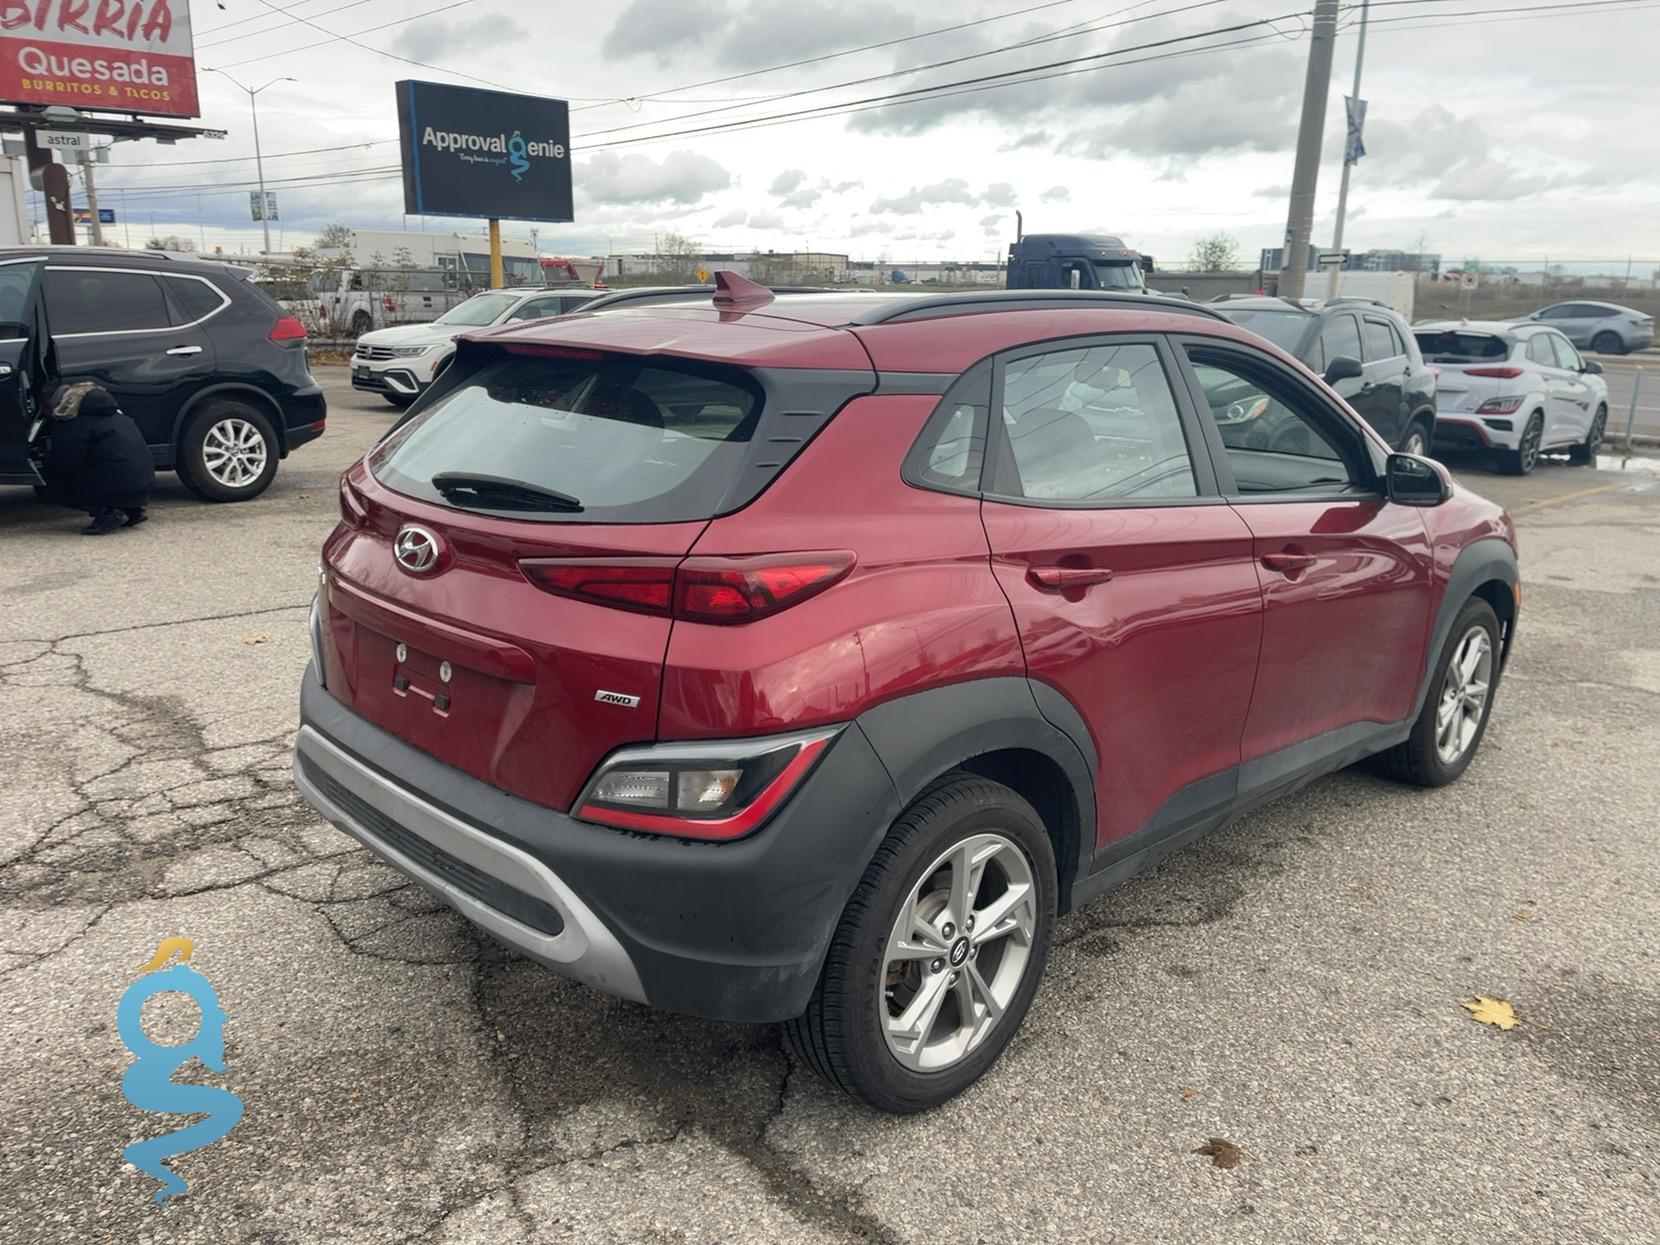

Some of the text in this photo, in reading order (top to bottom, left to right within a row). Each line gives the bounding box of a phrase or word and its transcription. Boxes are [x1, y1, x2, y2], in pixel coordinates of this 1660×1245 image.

[17, 46, 169, 86] Quesada
[21, 78, 171, 101] BURRITOS & TACOS
[47, 132, 81, 146] astral
[600, 693, 632, 705] AWD
